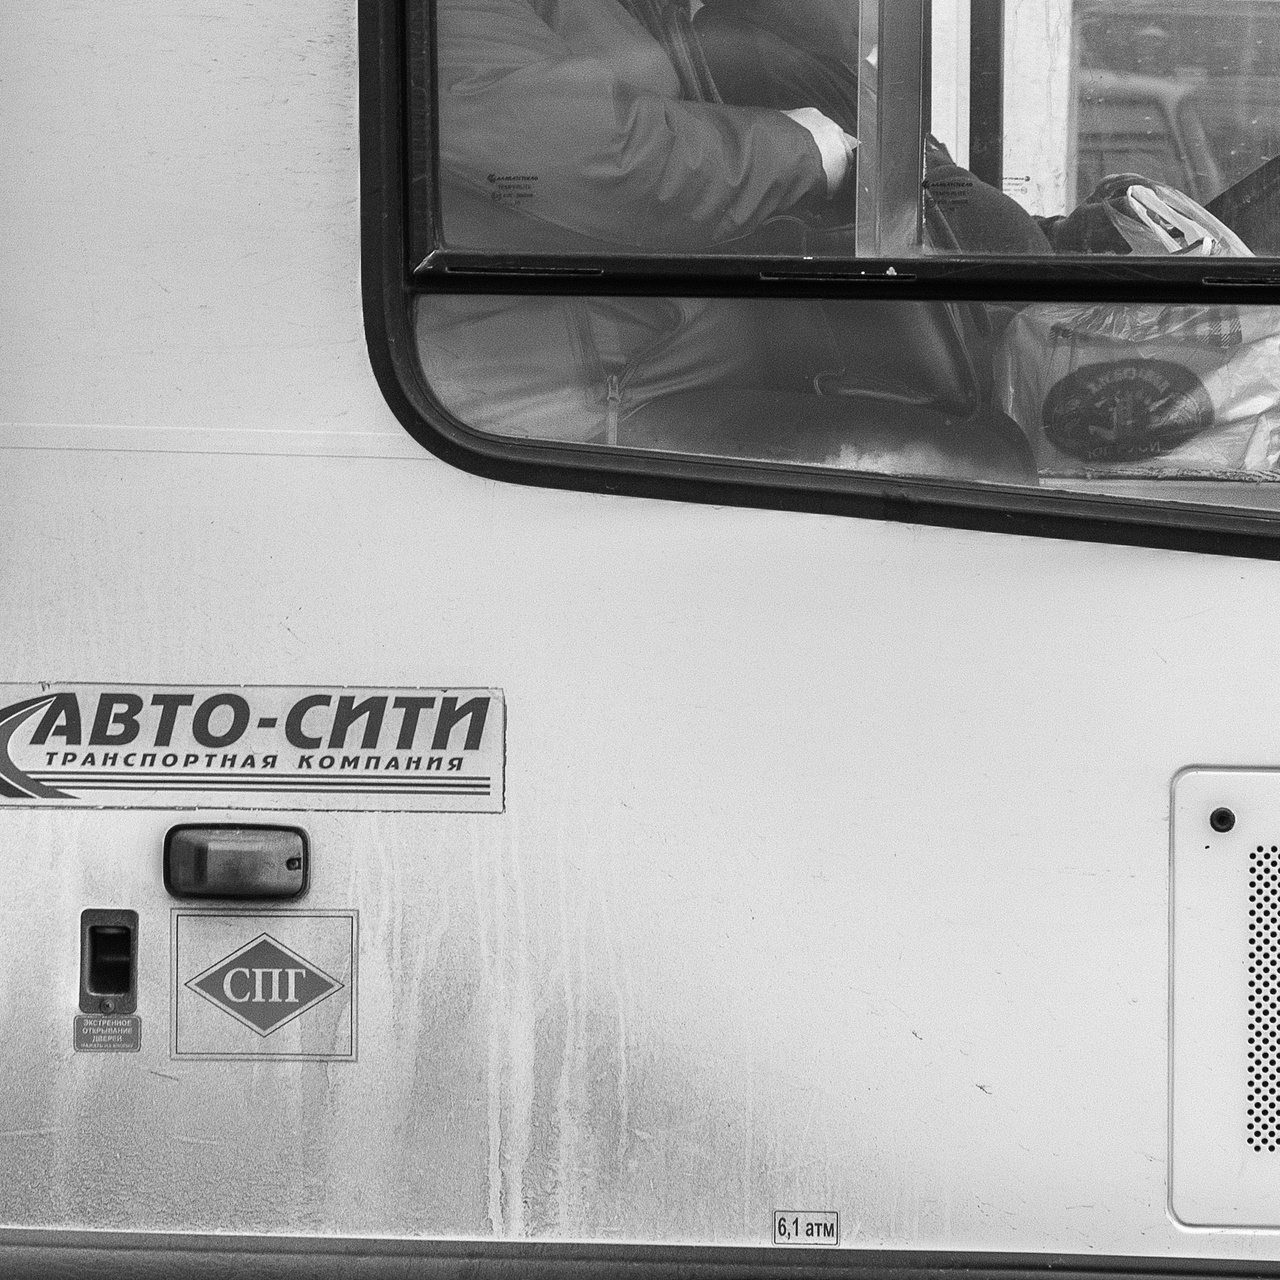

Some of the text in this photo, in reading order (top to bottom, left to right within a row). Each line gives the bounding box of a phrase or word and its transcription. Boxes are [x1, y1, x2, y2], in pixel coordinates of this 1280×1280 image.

[29, 693, 491, 750] АВТО-СИТИ
[46, 752, 463, 771] ТРАНСПОРТНАЯ КОМПАНИЯ
[223, 967, 306, 1003] СПГ
[92, 1035, 123, 1043] ДВЕРЕЙ
[778, 1217, 835, 1240] 6,1 атм
